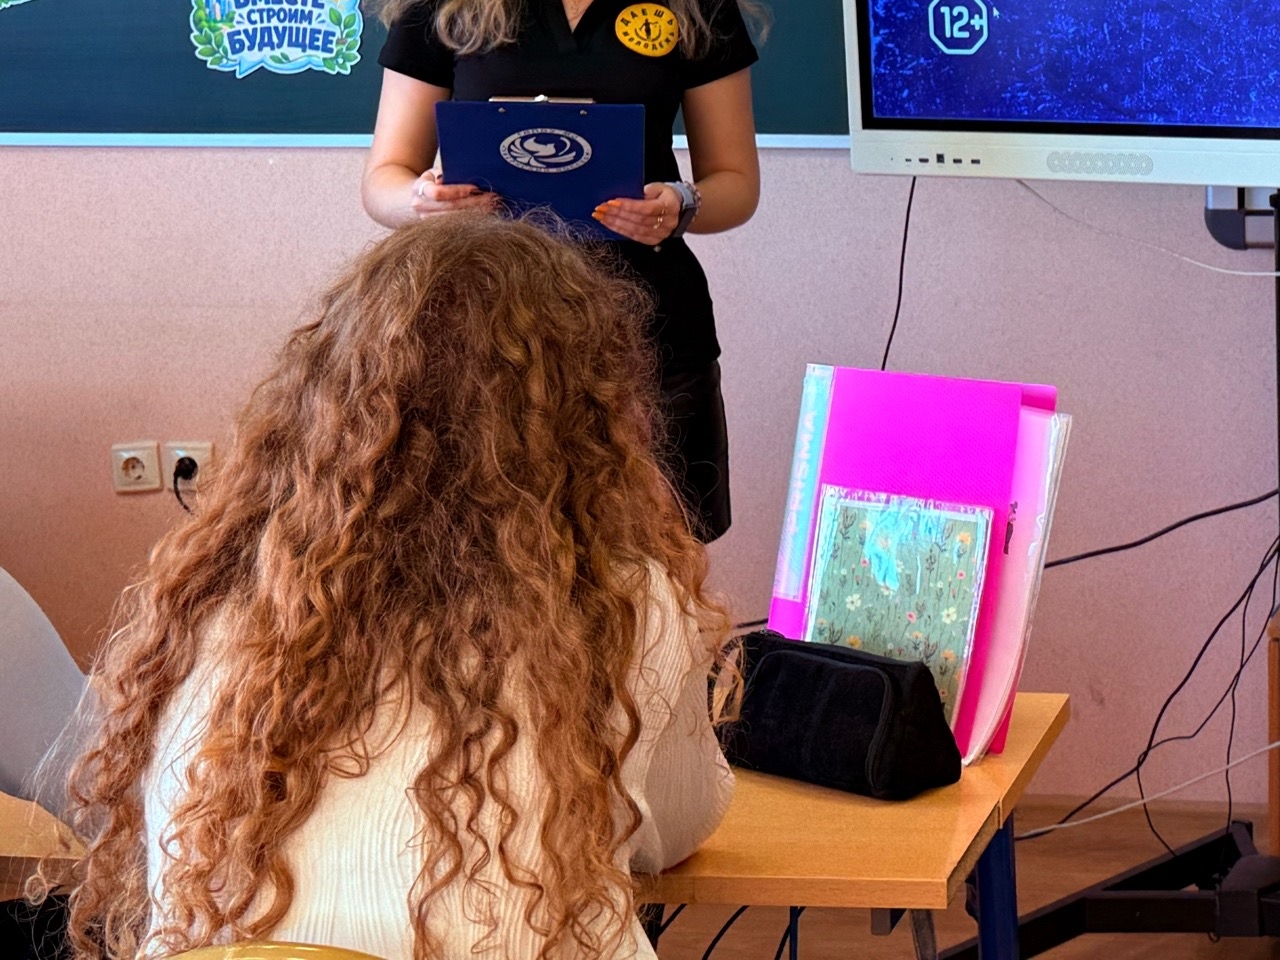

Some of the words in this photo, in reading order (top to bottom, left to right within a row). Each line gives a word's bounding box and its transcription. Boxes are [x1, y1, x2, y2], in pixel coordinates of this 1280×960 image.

[246, 8, 314, 25] СТРОИМ
[940, 5, 985, 38] 12+
[226, 25, 336, 55] БУДУЩЕЕ
